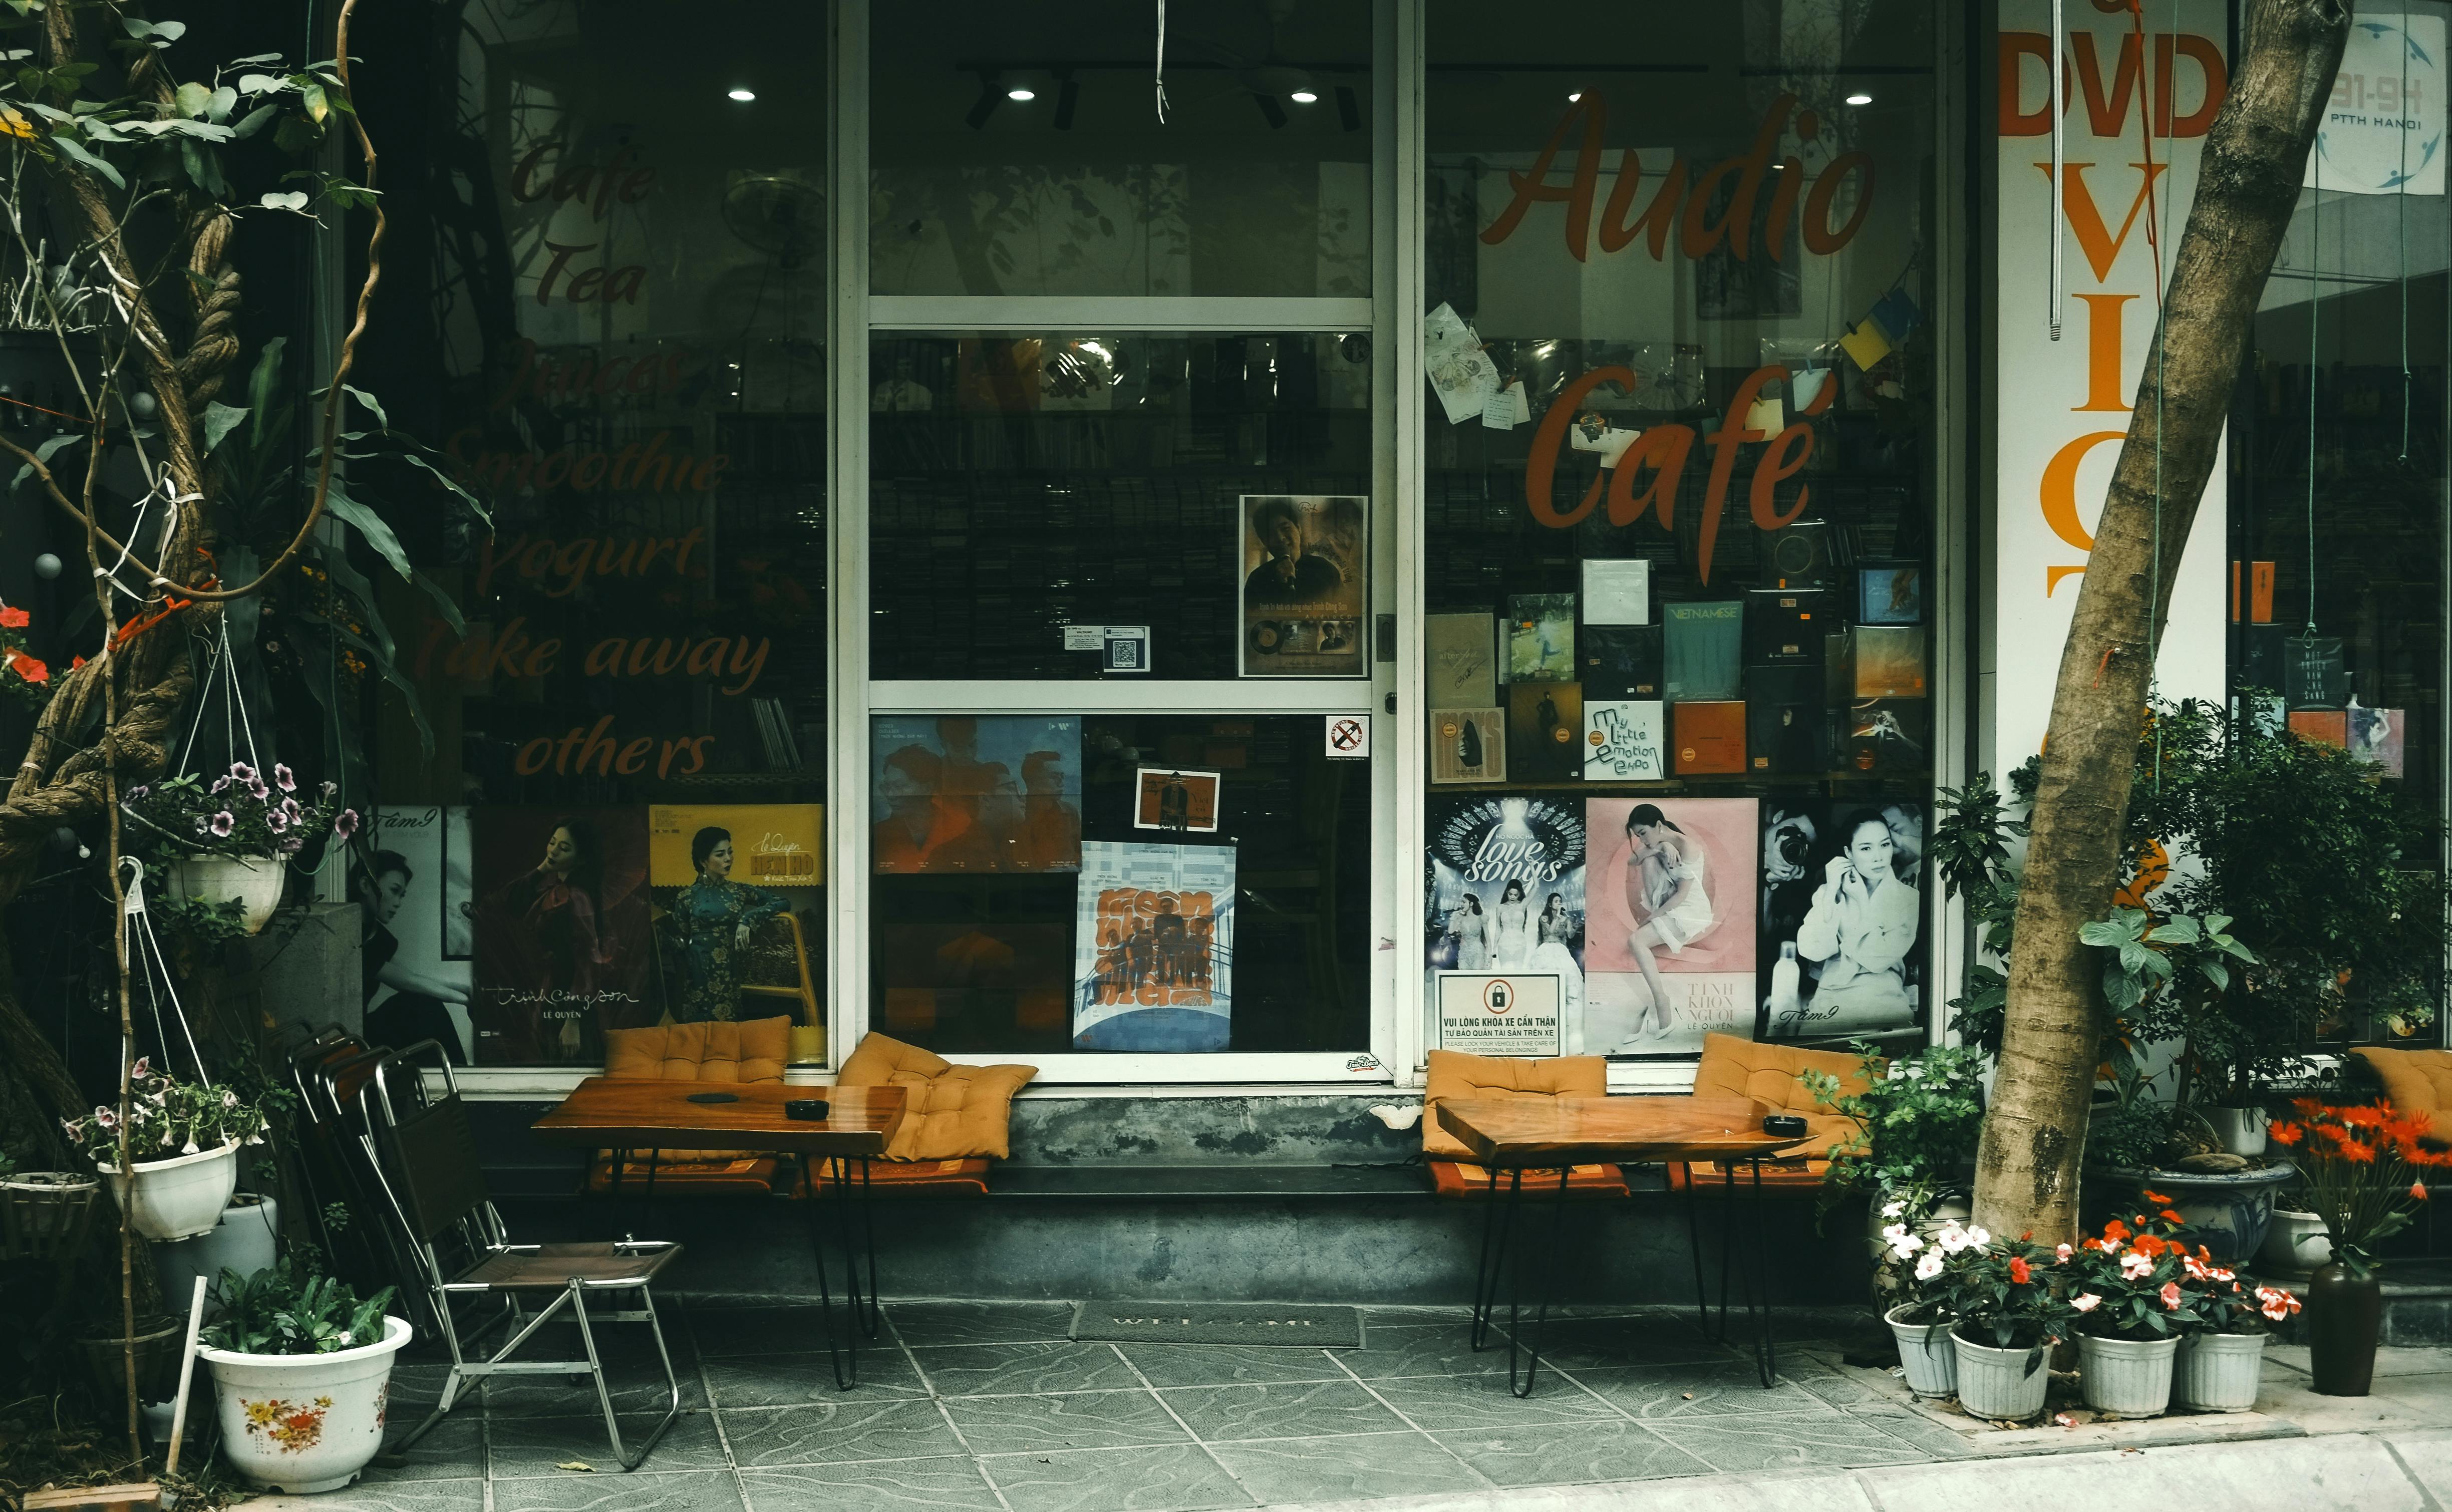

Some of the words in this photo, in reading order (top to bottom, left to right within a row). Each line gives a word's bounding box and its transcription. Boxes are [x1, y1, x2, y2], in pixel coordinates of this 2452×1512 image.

[1998, 32, 2228, 138] DVD
[2331, 114, 2366, 125] PTTH
[2374, 117, 2421, 130] HANOI
[1479, 86, 1875, 262] Audio
[537, 240, 647, 307] Tea
[489, 337, 690, 412] Juices
[429, 425, 730, 492] Smoothie
[1525, 364, 1838, 588] Café
[476, 526, 707, 598] Yogurt
[1670, 607, 1738, 619] VIETNAMESE
[413, 616, 562, 679] Take
[585, 634, 771, 696] away
[515, 714, 715, 780] others
[1464, 861, 1562, 892] songs
[1475, 824, 1548, 863] love
[1444, 1018, 1457, 1027] VUI
[1459, 1016, 1479, 1027] LÒNG
[1482, 1016, 1503, 1027] KHÓA
[1505, 1018, 1514, 1026] XE
[1517, 1014, 1532, 1026] CẨN
[1535, 1015, 1556, 1028] THẬN
[1456, 1028, 1471, 1036] BẢO
[1472, 1028, 1492, 1036] QUẢN
[1507, 1028, 1521, 1036] SẢN
[1523, 1028, 1543, 1036] TRÊN
